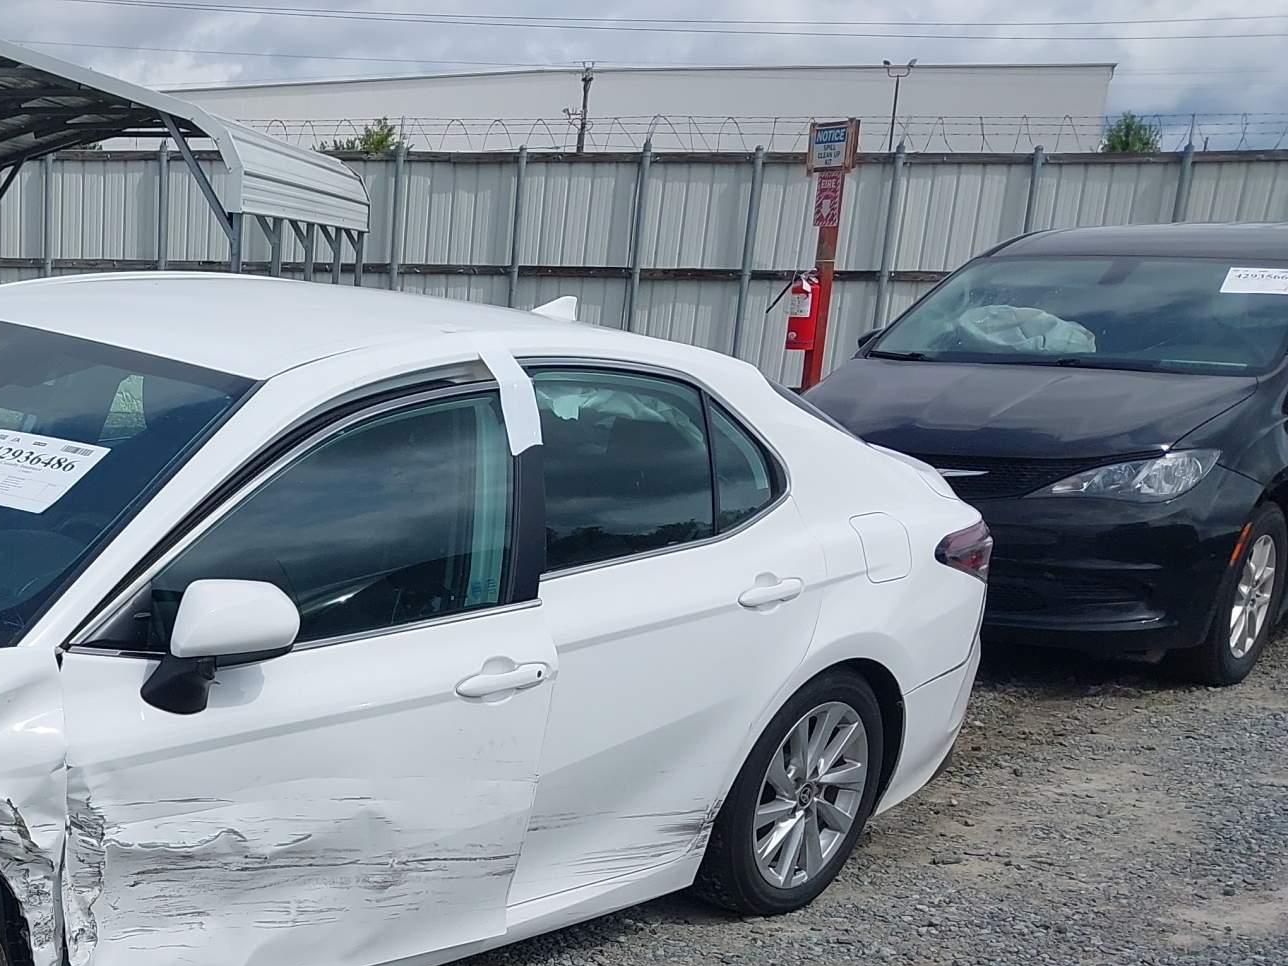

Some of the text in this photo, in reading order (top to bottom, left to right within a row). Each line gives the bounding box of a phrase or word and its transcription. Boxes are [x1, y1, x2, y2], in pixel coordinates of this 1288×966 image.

[816, 128, 846, 142] NOTICE
[817, 150, 841, 159] CLEAN UP
